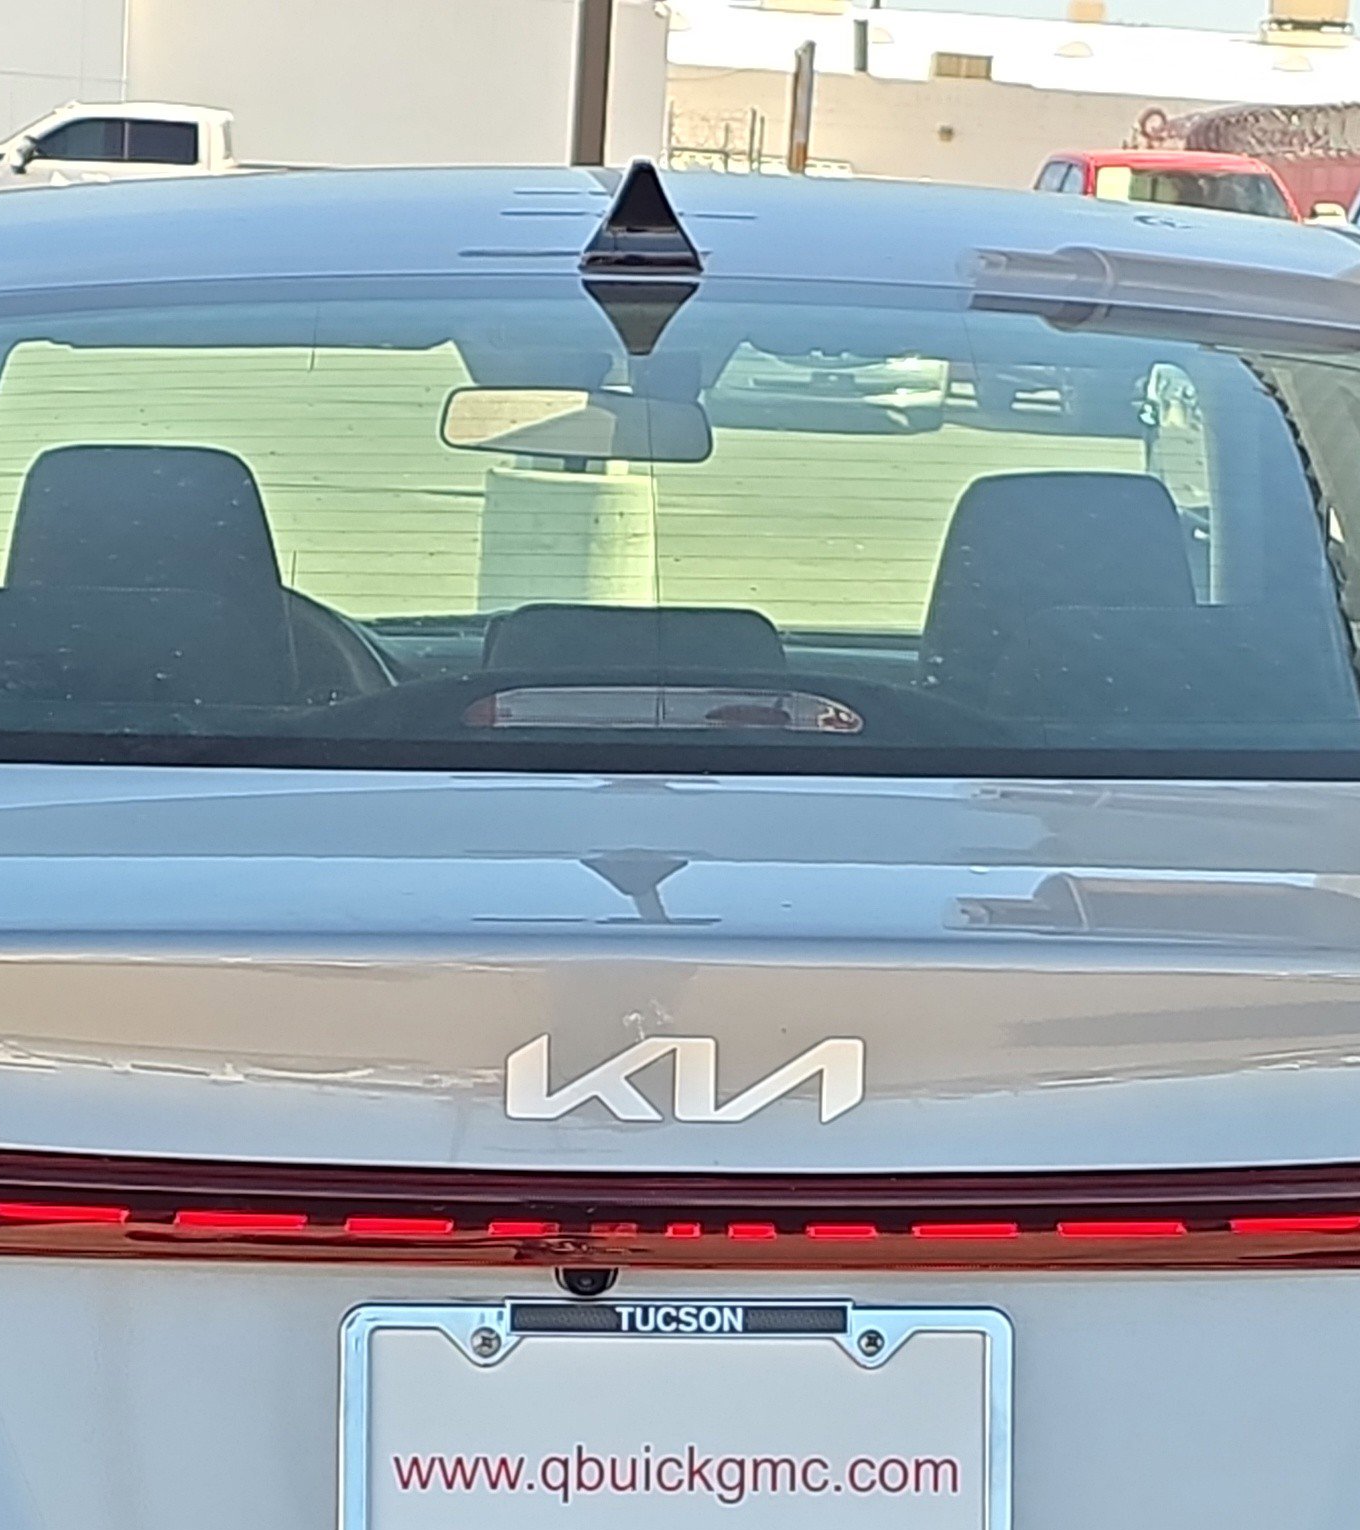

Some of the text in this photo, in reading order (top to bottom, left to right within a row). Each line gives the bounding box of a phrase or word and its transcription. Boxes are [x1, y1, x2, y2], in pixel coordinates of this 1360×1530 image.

[505, 1032, 865, 1125] KIA
[614, 1306, 744, 1332] TUCSON
[393, 1445, 959, 1503] www.qbuickgmc.com
